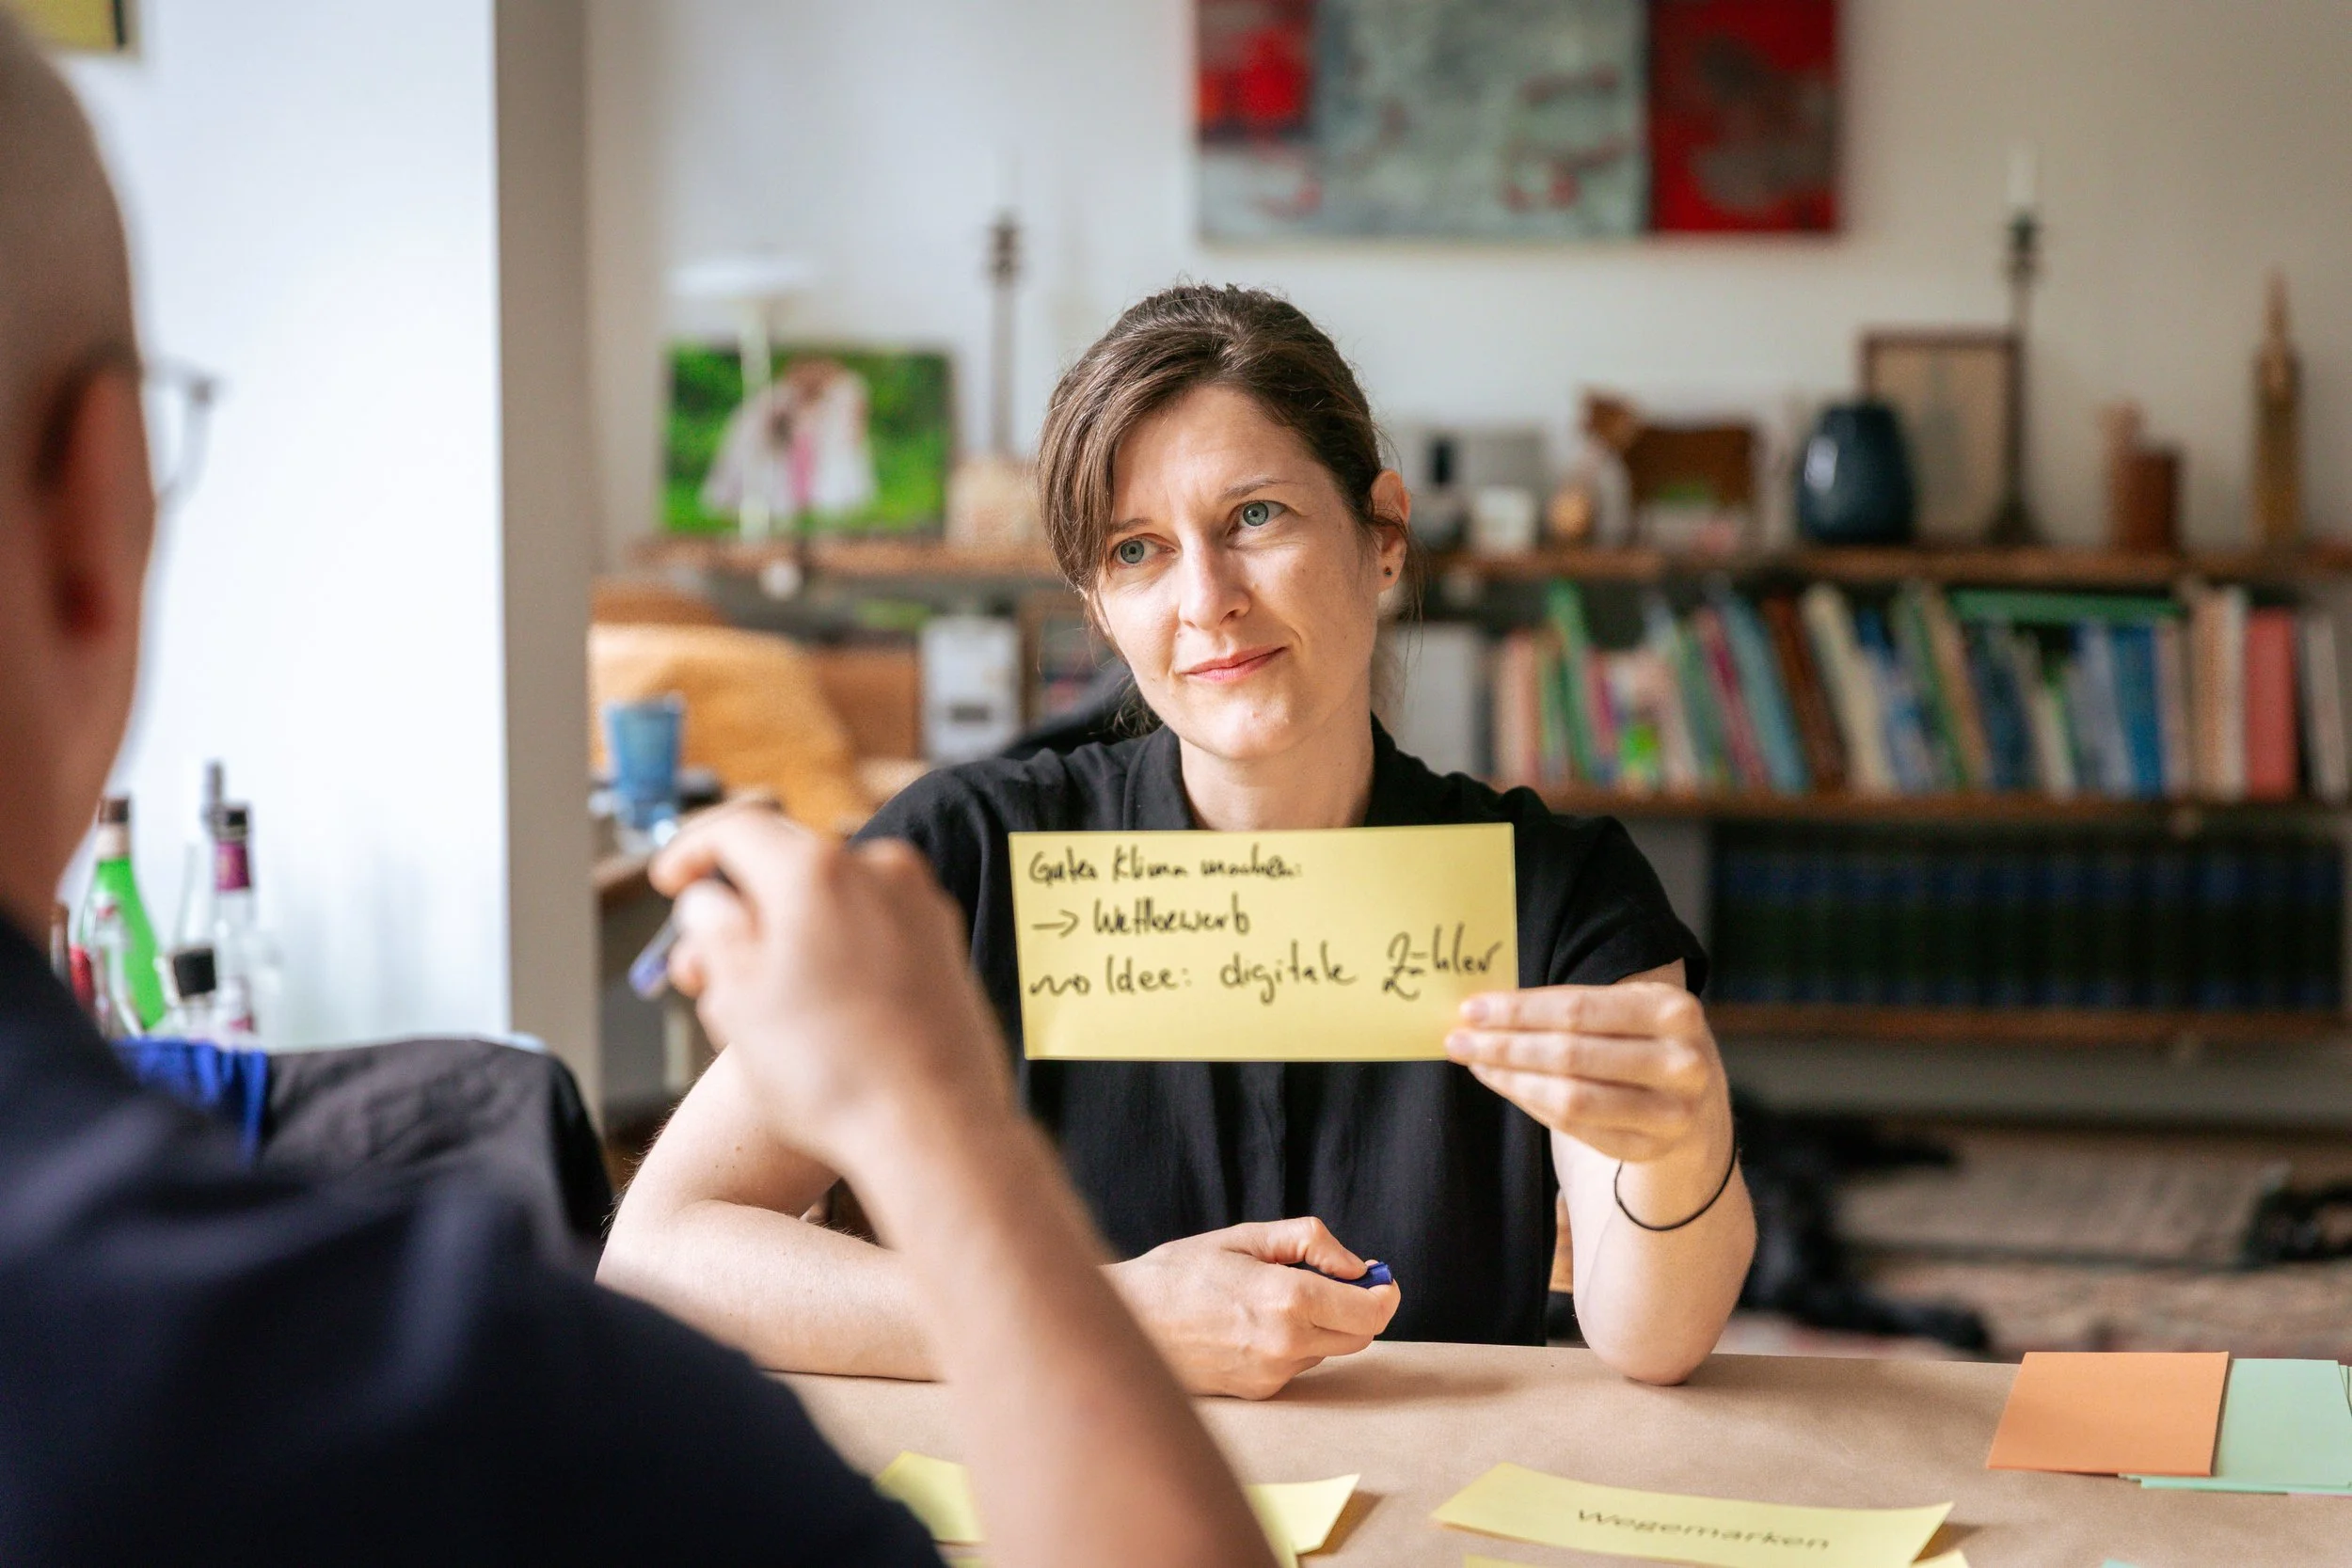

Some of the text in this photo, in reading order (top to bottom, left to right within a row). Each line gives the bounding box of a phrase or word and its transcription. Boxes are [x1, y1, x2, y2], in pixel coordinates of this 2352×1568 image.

[1112, 844, 1188, 882] Klima
[1093, 892, 1251, 936] Wettbewerb
[1105, 953, 1193, 996] Idee:
[1219, 938, 1359, 1006] digitale
[1579, 1509, 1830, 1551] Wegemarken
